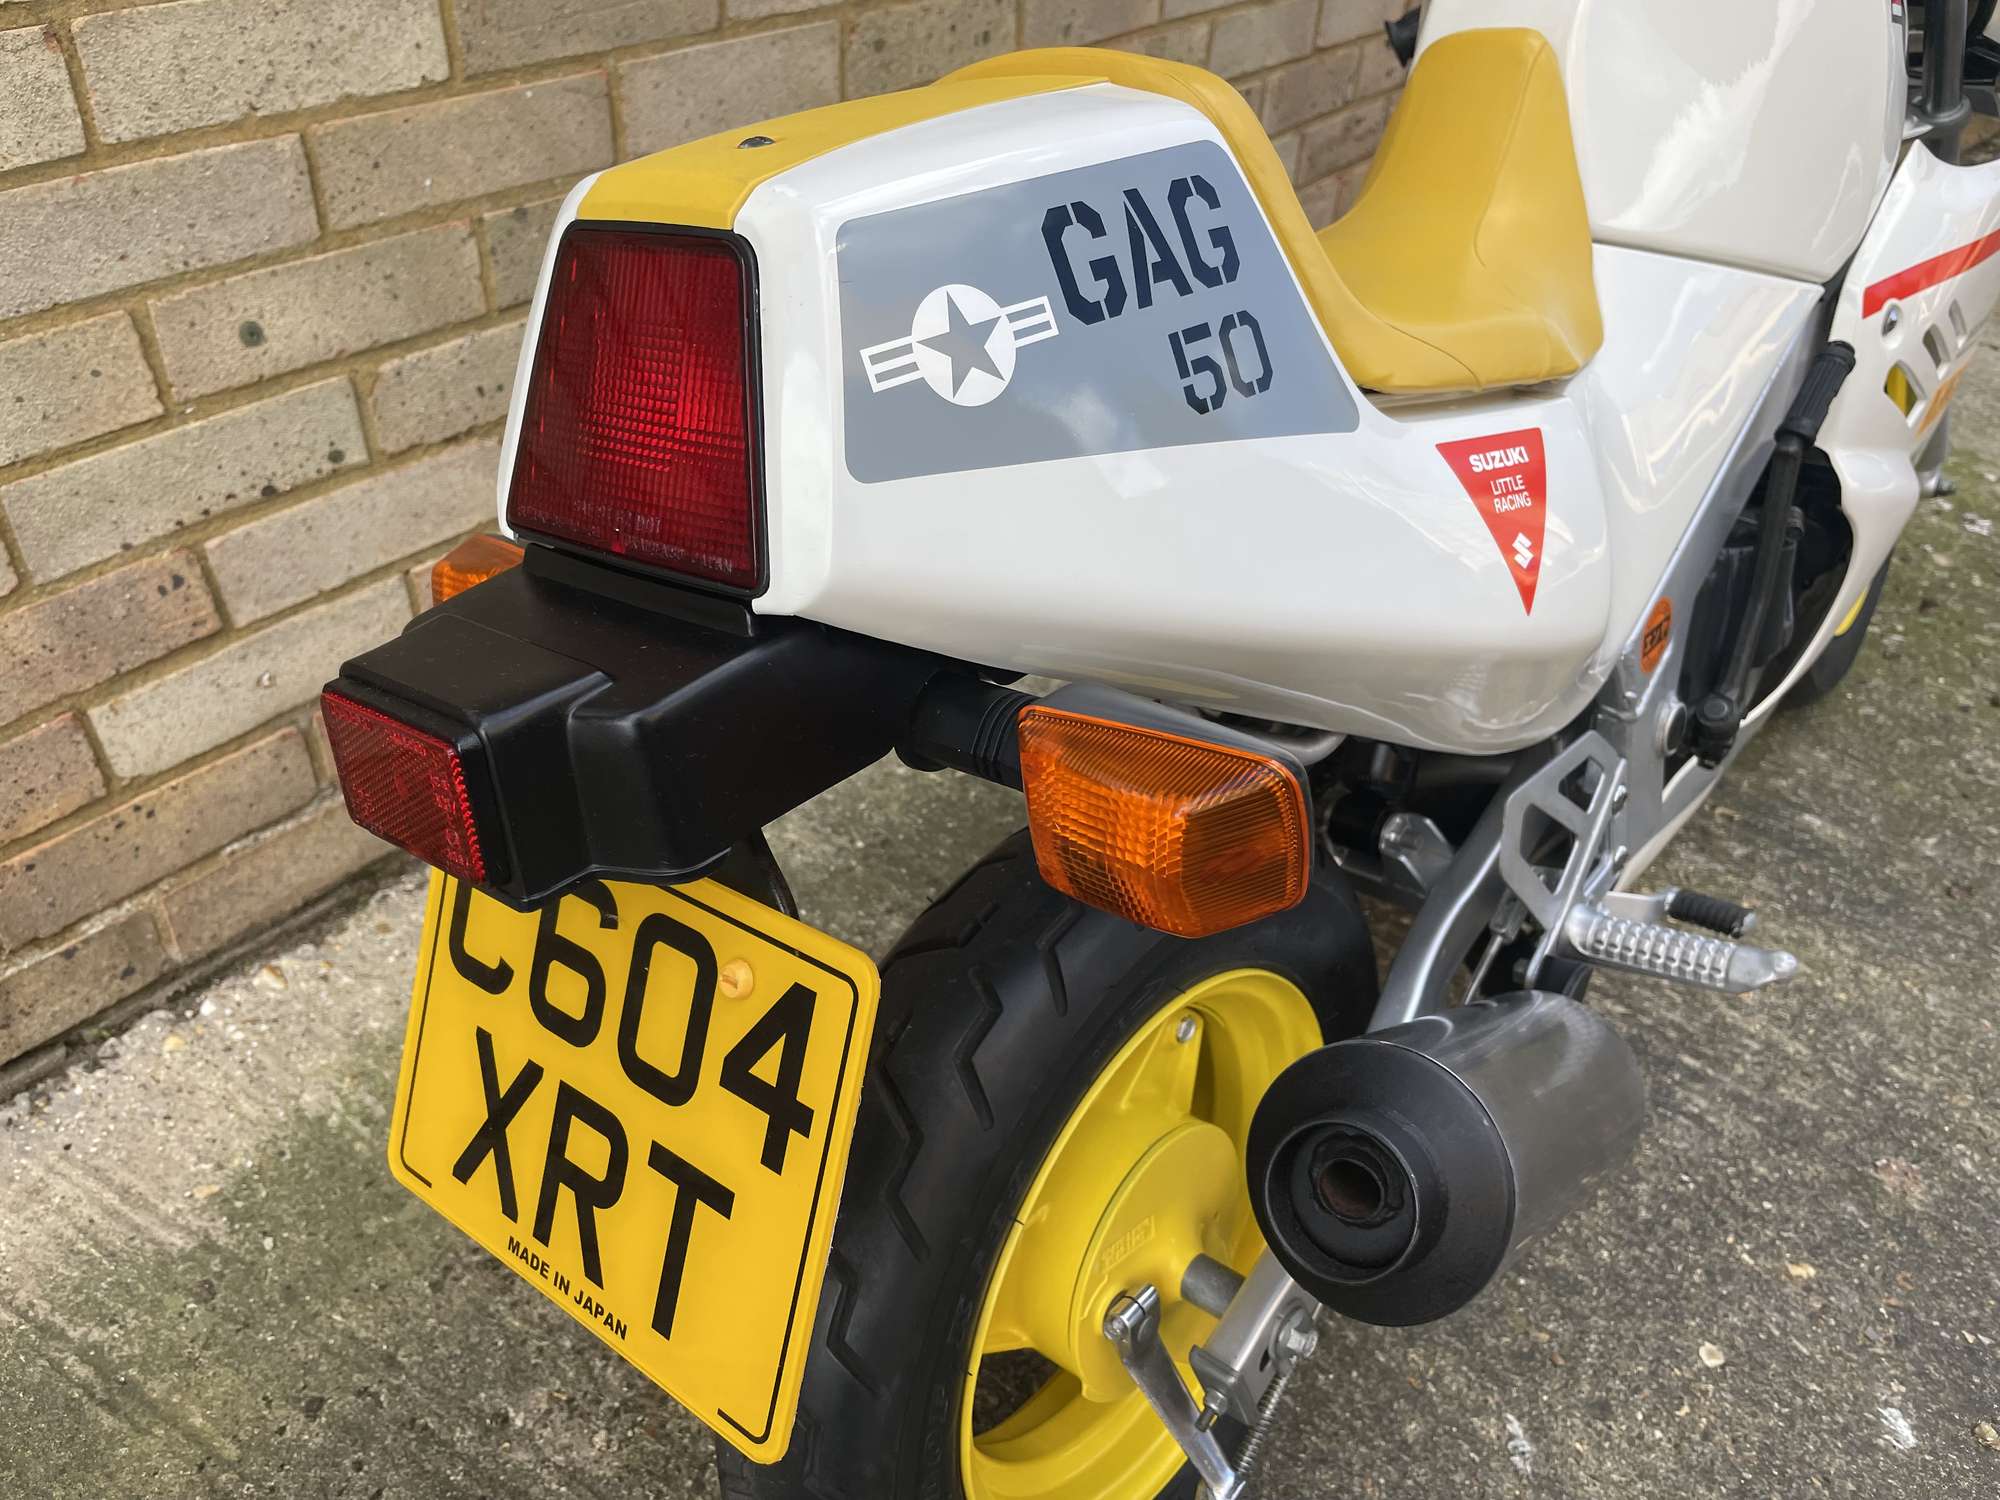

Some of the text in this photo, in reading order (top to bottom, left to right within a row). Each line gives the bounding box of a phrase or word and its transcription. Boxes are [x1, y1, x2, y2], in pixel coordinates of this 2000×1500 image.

[1041, 174, 1241, 326] GAG
[1168, 310, 1273, 415] 50
[1469, 446, 1529, 473] SUZUKI
[1490, 474, 1525, 496] LITTLE
[1493, 491, 1532, 514] RACING
[452, 1026, 736, 1341] XRT
[507, 1235, 628, 1341] MADE IN JAPAN
